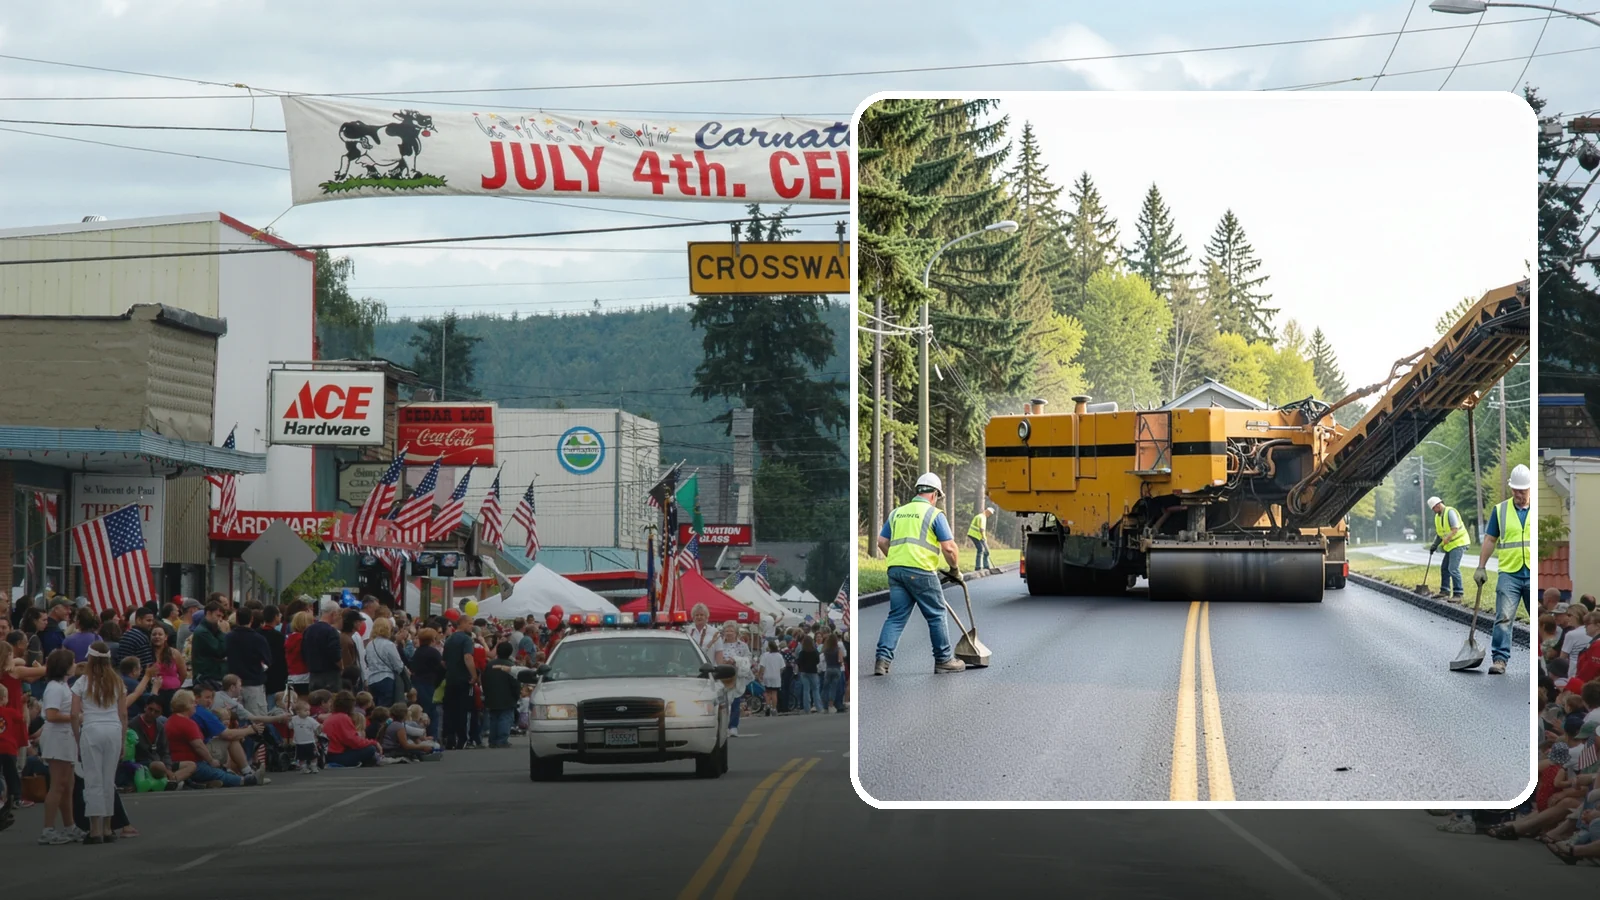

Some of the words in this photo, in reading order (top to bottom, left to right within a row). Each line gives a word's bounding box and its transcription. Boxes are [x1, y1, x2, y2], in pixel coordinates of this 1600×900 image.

[695, 121, 850, 150] Carnat
[481, 141, 605, 193] JULY
[632, 150, 746, 198] 4th.
[697, 254, 850, 280] CROSSWA
[283, 380, 373, 420] ACE
[406, 409, 452, 422] CEDAR
[283, 421, 371, 436] Hardware
[416, 428, 477, 447] Coca-Cola
[353, 466, 386, 481] Simpl
[95, 485, 124, 494] Vincent
[126, 486, 136, 494] de
[138, 486, 155, 495] Paul
[80, 503, 154, 522] THT
[212, 516, 330, 535] HARDARE
[688, 526, 741, 535] CRNATION
[699, 535, 730, 543] GLASS
